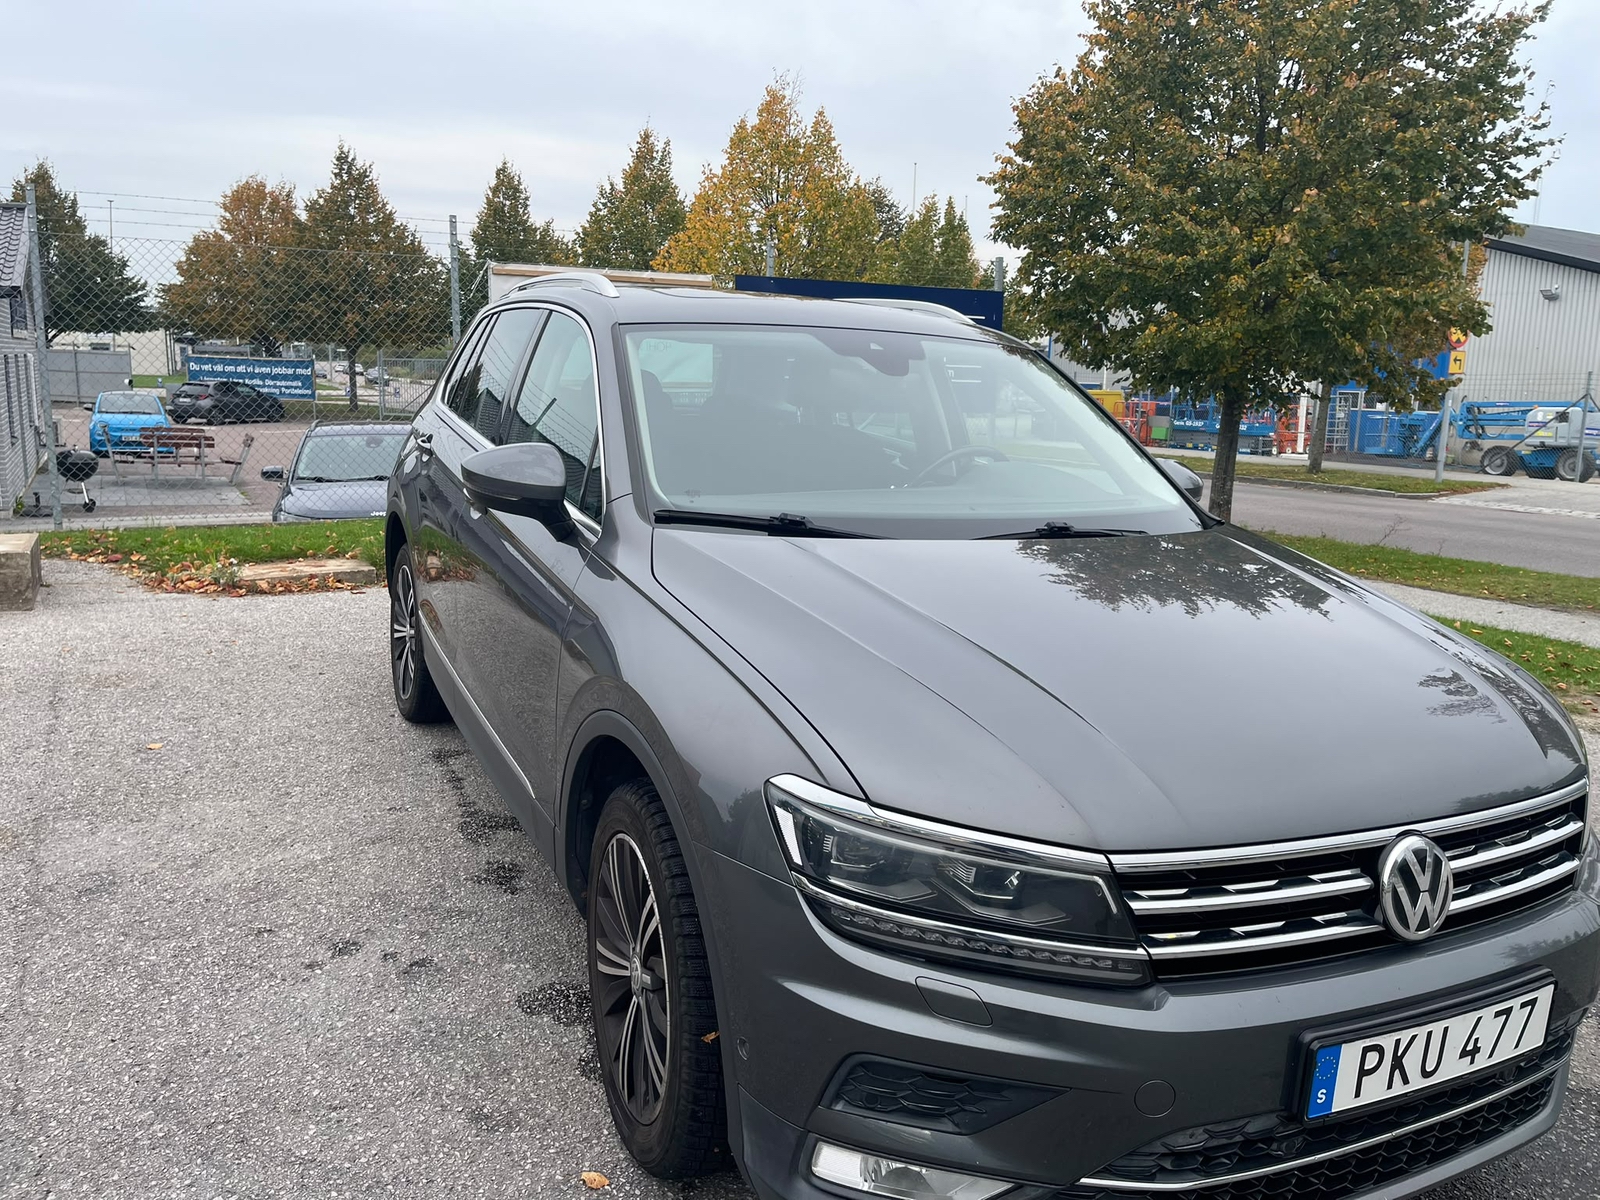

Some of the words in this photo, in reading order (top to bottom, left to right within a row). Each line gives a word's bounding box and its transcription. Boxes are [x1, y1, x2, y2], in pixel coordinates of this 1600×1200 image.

[190, 362, 200, 370] Du
[201, 363, 212, 371] vet
[237, 364, 246, 373] att
[247, 365, 253, 373] vi
[271, 366, 294, 375] jobbar
[295, 367, 311, 375] med
[1354, 1025, 1449, 1099] PKU
[1458, 996, 1539, 1066] 477
[1316, 1088, 1327, 1104] S
